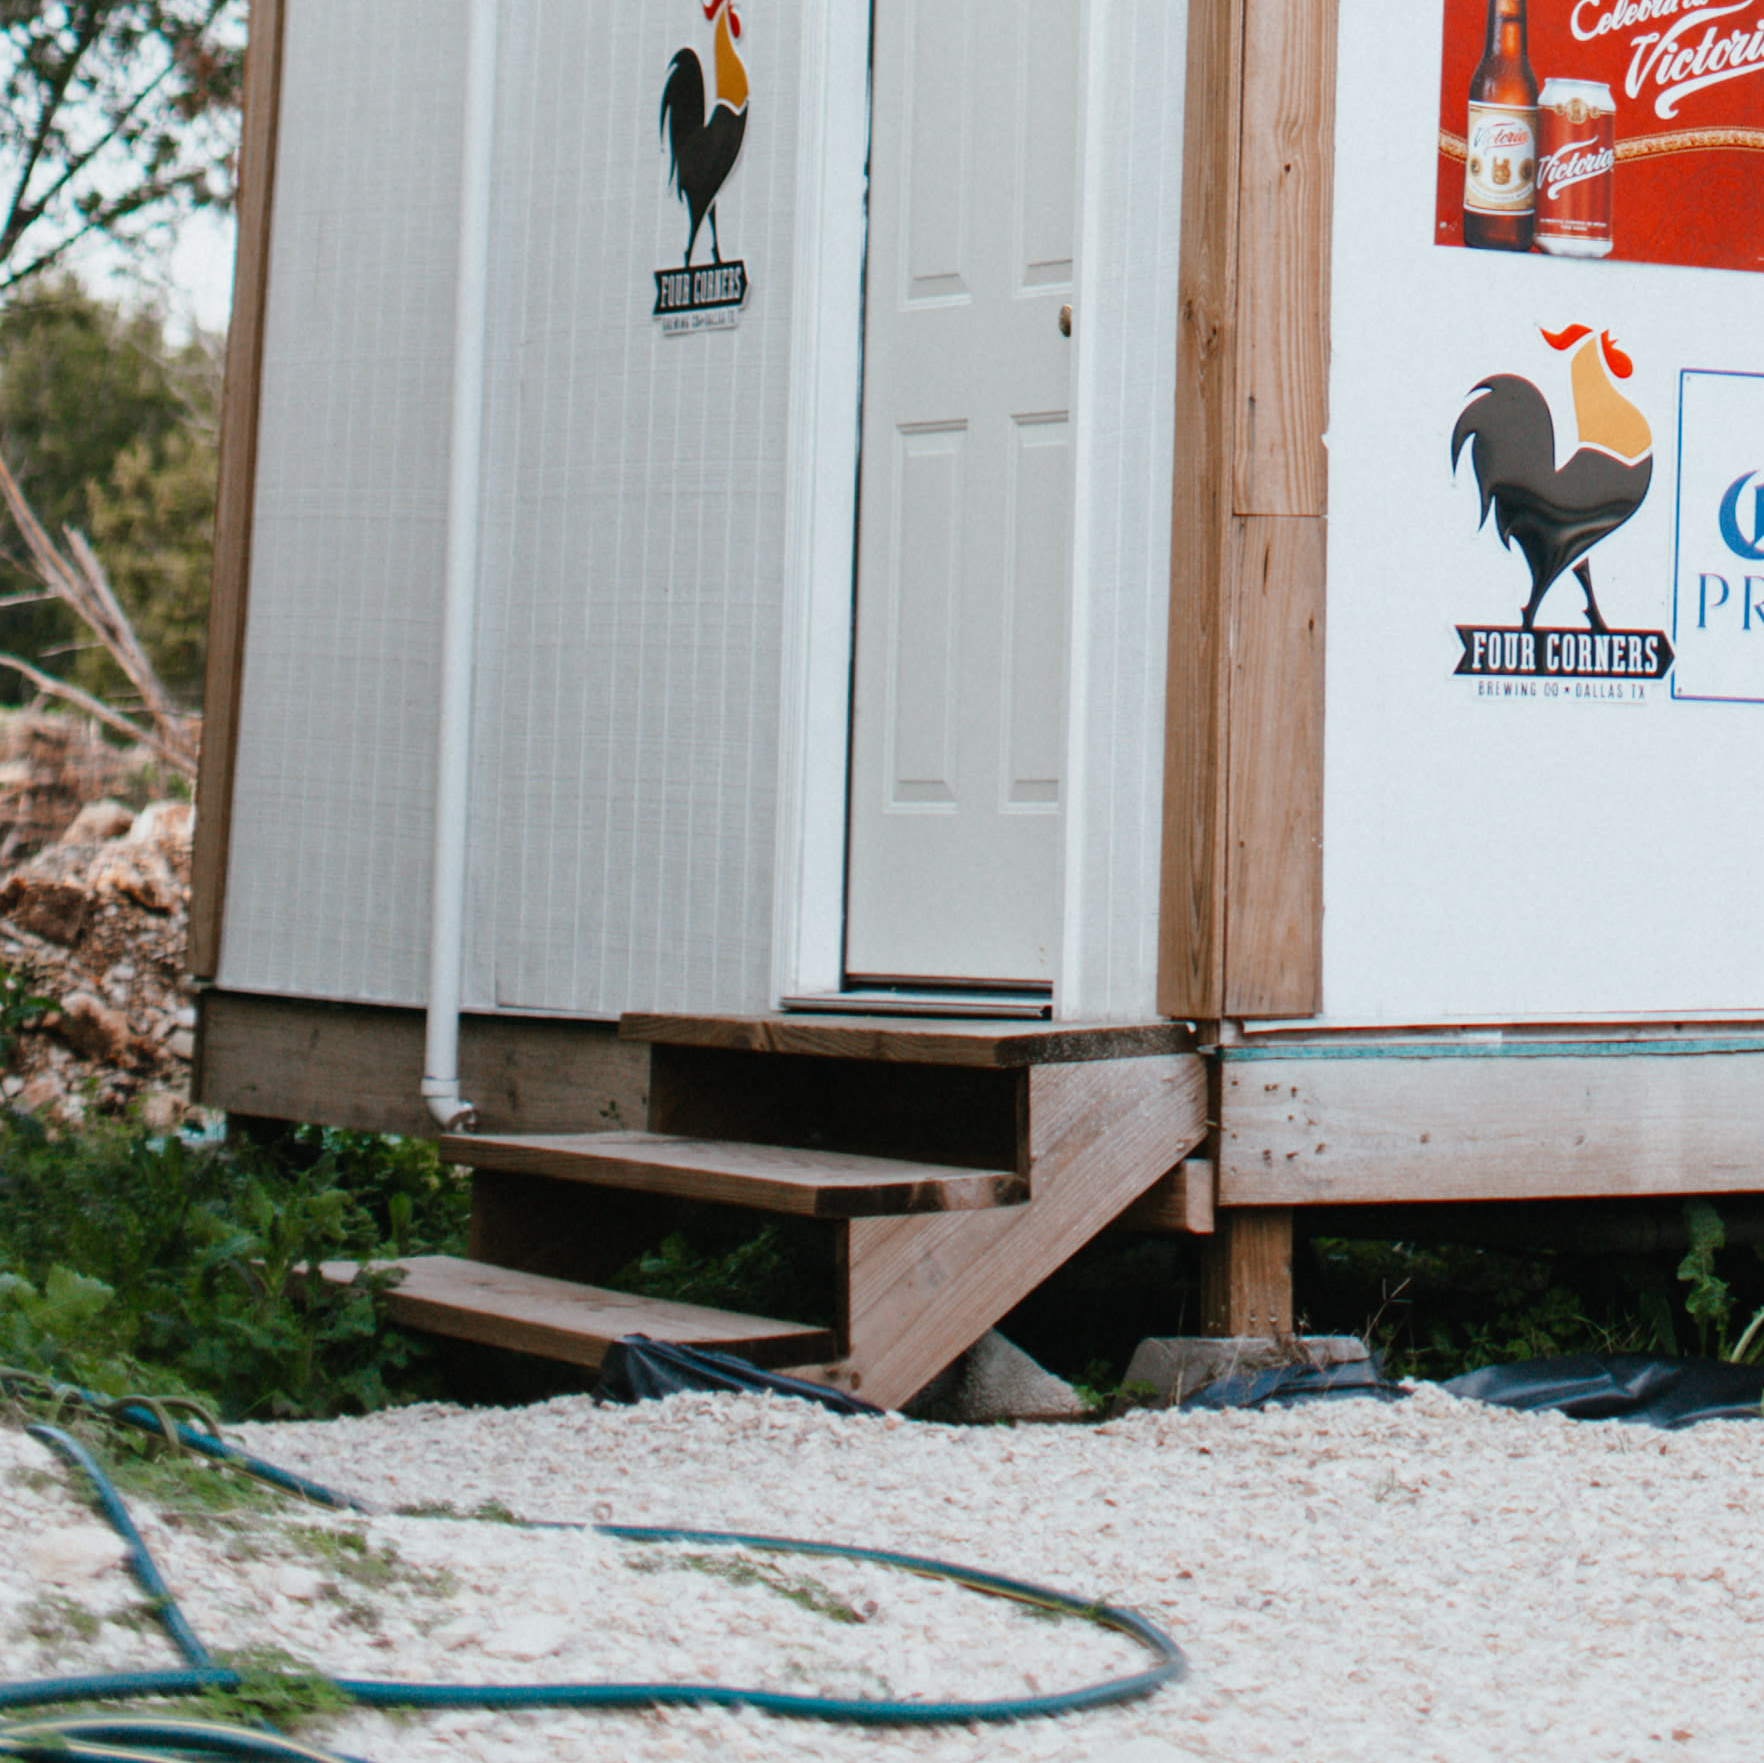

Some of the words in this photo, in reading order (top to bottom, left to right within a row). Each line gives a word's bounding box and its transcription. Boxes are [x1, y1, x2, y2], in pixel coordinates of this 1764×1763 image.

[1537, 135, 1614, 200] Victoria
[661, 273, 690, 309] FOUR
[694, 266, 742, 305] CORNERS
[1471, 630, 1536, 673] FOUR
[1546, 632, 1659, 676] CORNERS
[1478, 680, 1537, 697] BREWING
[1543, 681, 1559, 698] CO
[1575, 682, 1624, 698] DALLAS
[1631, 683, 1645, 698] TX
